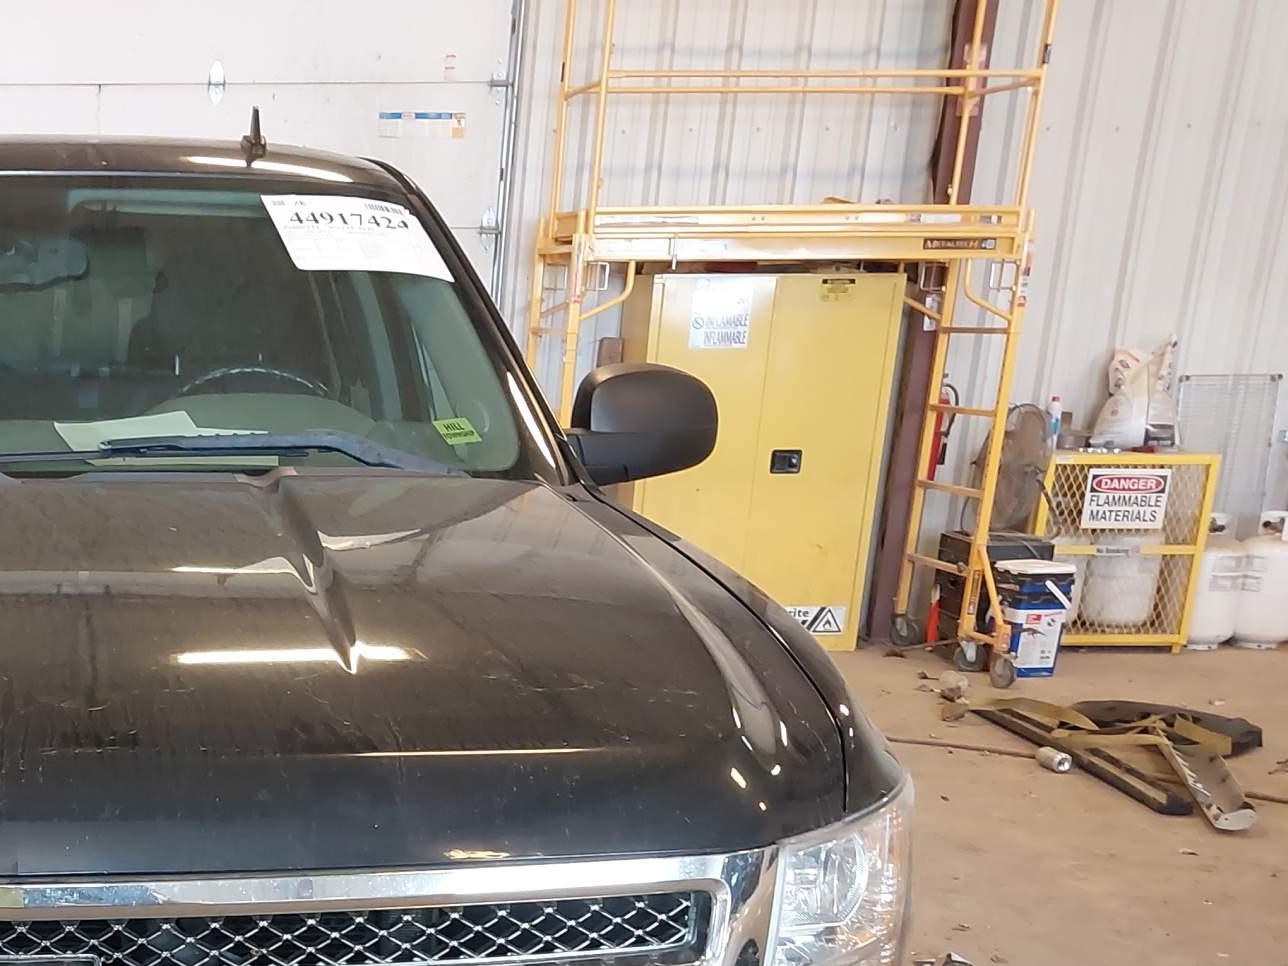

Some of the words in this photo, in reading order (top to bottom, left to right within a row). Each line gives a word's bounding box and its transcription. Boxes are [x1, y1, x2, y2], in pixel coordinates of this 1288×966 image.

[443, 422, 465, 432] HILL
[1100, 478, 1158, 490] DANGER
[1088, 494, 1163, 508] FLAMMABLE
[1088, 509, 1158, 522] MATERIALS
